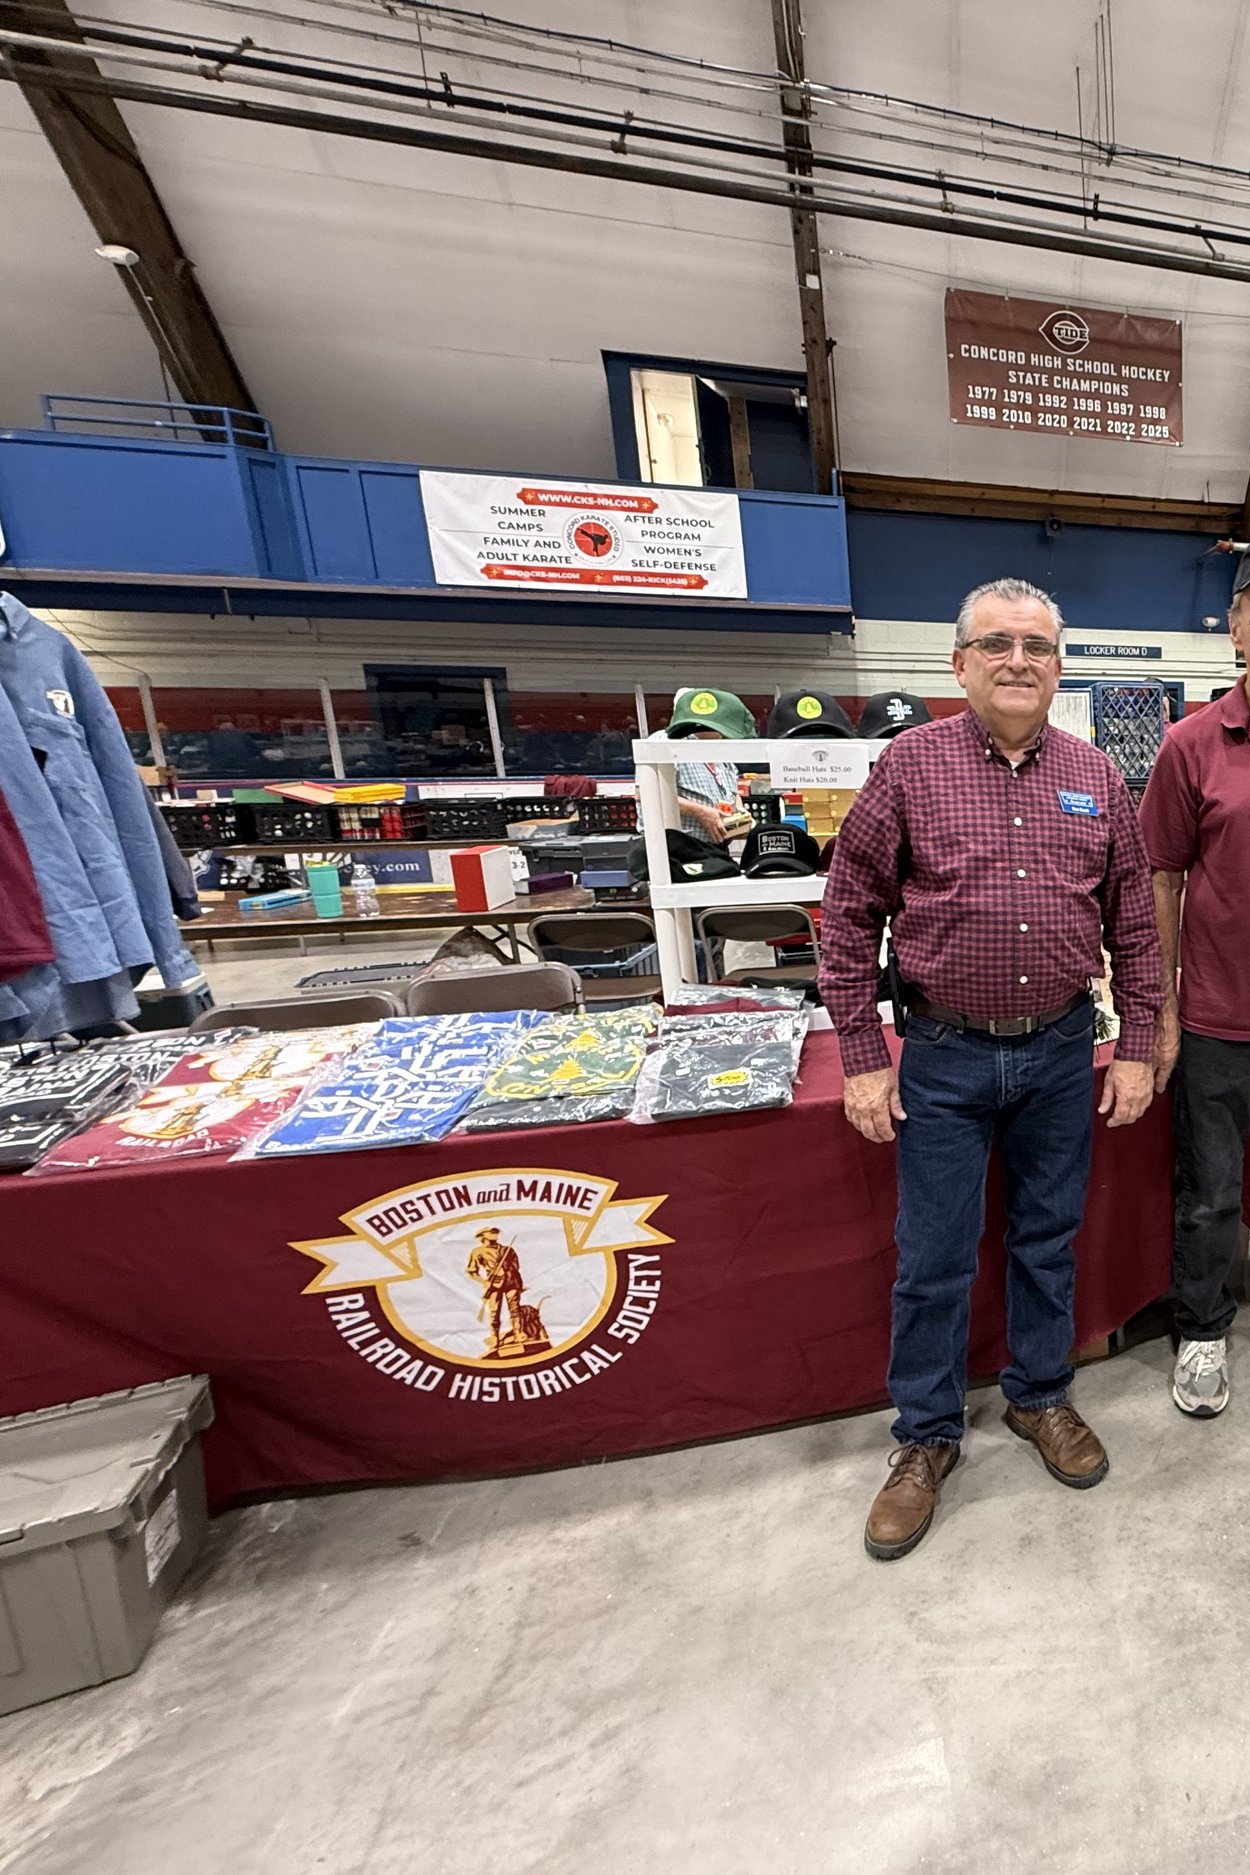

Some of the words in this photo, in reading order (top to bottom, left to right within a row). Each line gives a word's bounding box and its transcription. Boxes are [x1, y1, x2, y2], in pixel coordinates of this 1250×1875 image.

[1054, 326, 1088, 339] TIDE
[961, 344, 1025, 365] CONCORD
[1031, 353, 1061, 369] HIGH
[1067, 358, 1117, 376] SCHOOL
[1122, 365, 1170, 382] HOCKEY
[1008, 370, 1049, 387] STATE
[1053, 375, 1129, 397] CHAMPIONS
[968, 385, 997, 400] 1977
[1003, 389, 1032, 405] 1979
[1039, 393, 1067, 409] 1992
[1073, 397, 1101, 412] 1996
[1107, 401, 1134, 416] 1997
[1139, 405, 1166, 420] 1998
[966, 404, 996, 420] 1999
[1002, 408, 1032, 424] 2010
[1038, 413, 1067, 428] 2020
[1073, 417, 1101, 432] 2021
[1107, 420, 1135, 435] 2022
[1141, 423, 1169, 438] 2025
[538, 493, 639, 508] WWW.CKS-NH.COM
[490, 506, 546, 518] SUMMER
[498, 521, 544, 532] CAMPS
[580, 515, 609, 526] KARATE
[624, 515, 662, 525] AFTER
[666, 517, 715, 528] SCHOOL
[641, 530, 701, 541] PROGRAM
[483, 537, 530, 548] FAMILY
[534, 540, 562, 549] AND
[476, 551, 519, 561] ADULT
[522, 554, 573, 564] KARATE
[644, 545, 702, 557] WOMEN'S
[631, 559, 717, 572] SELF-DEFENSE
[1084, 646, 1116, 655] LOCKER
[1117, 646, 1140, 656] ROOM
[1141, 648, 1148, 656] D
[366, 1183, 472, 1238] BOSTON
[477, 1182, 512, 1205] and
[516, 1179, 599, 1212] MAINE
[325, 1292, 445, 1392] RAILROAD
[448, 1343, 623, 1403] HISTORICAL
[608, 1253, 661, 1346] SOCIETY
